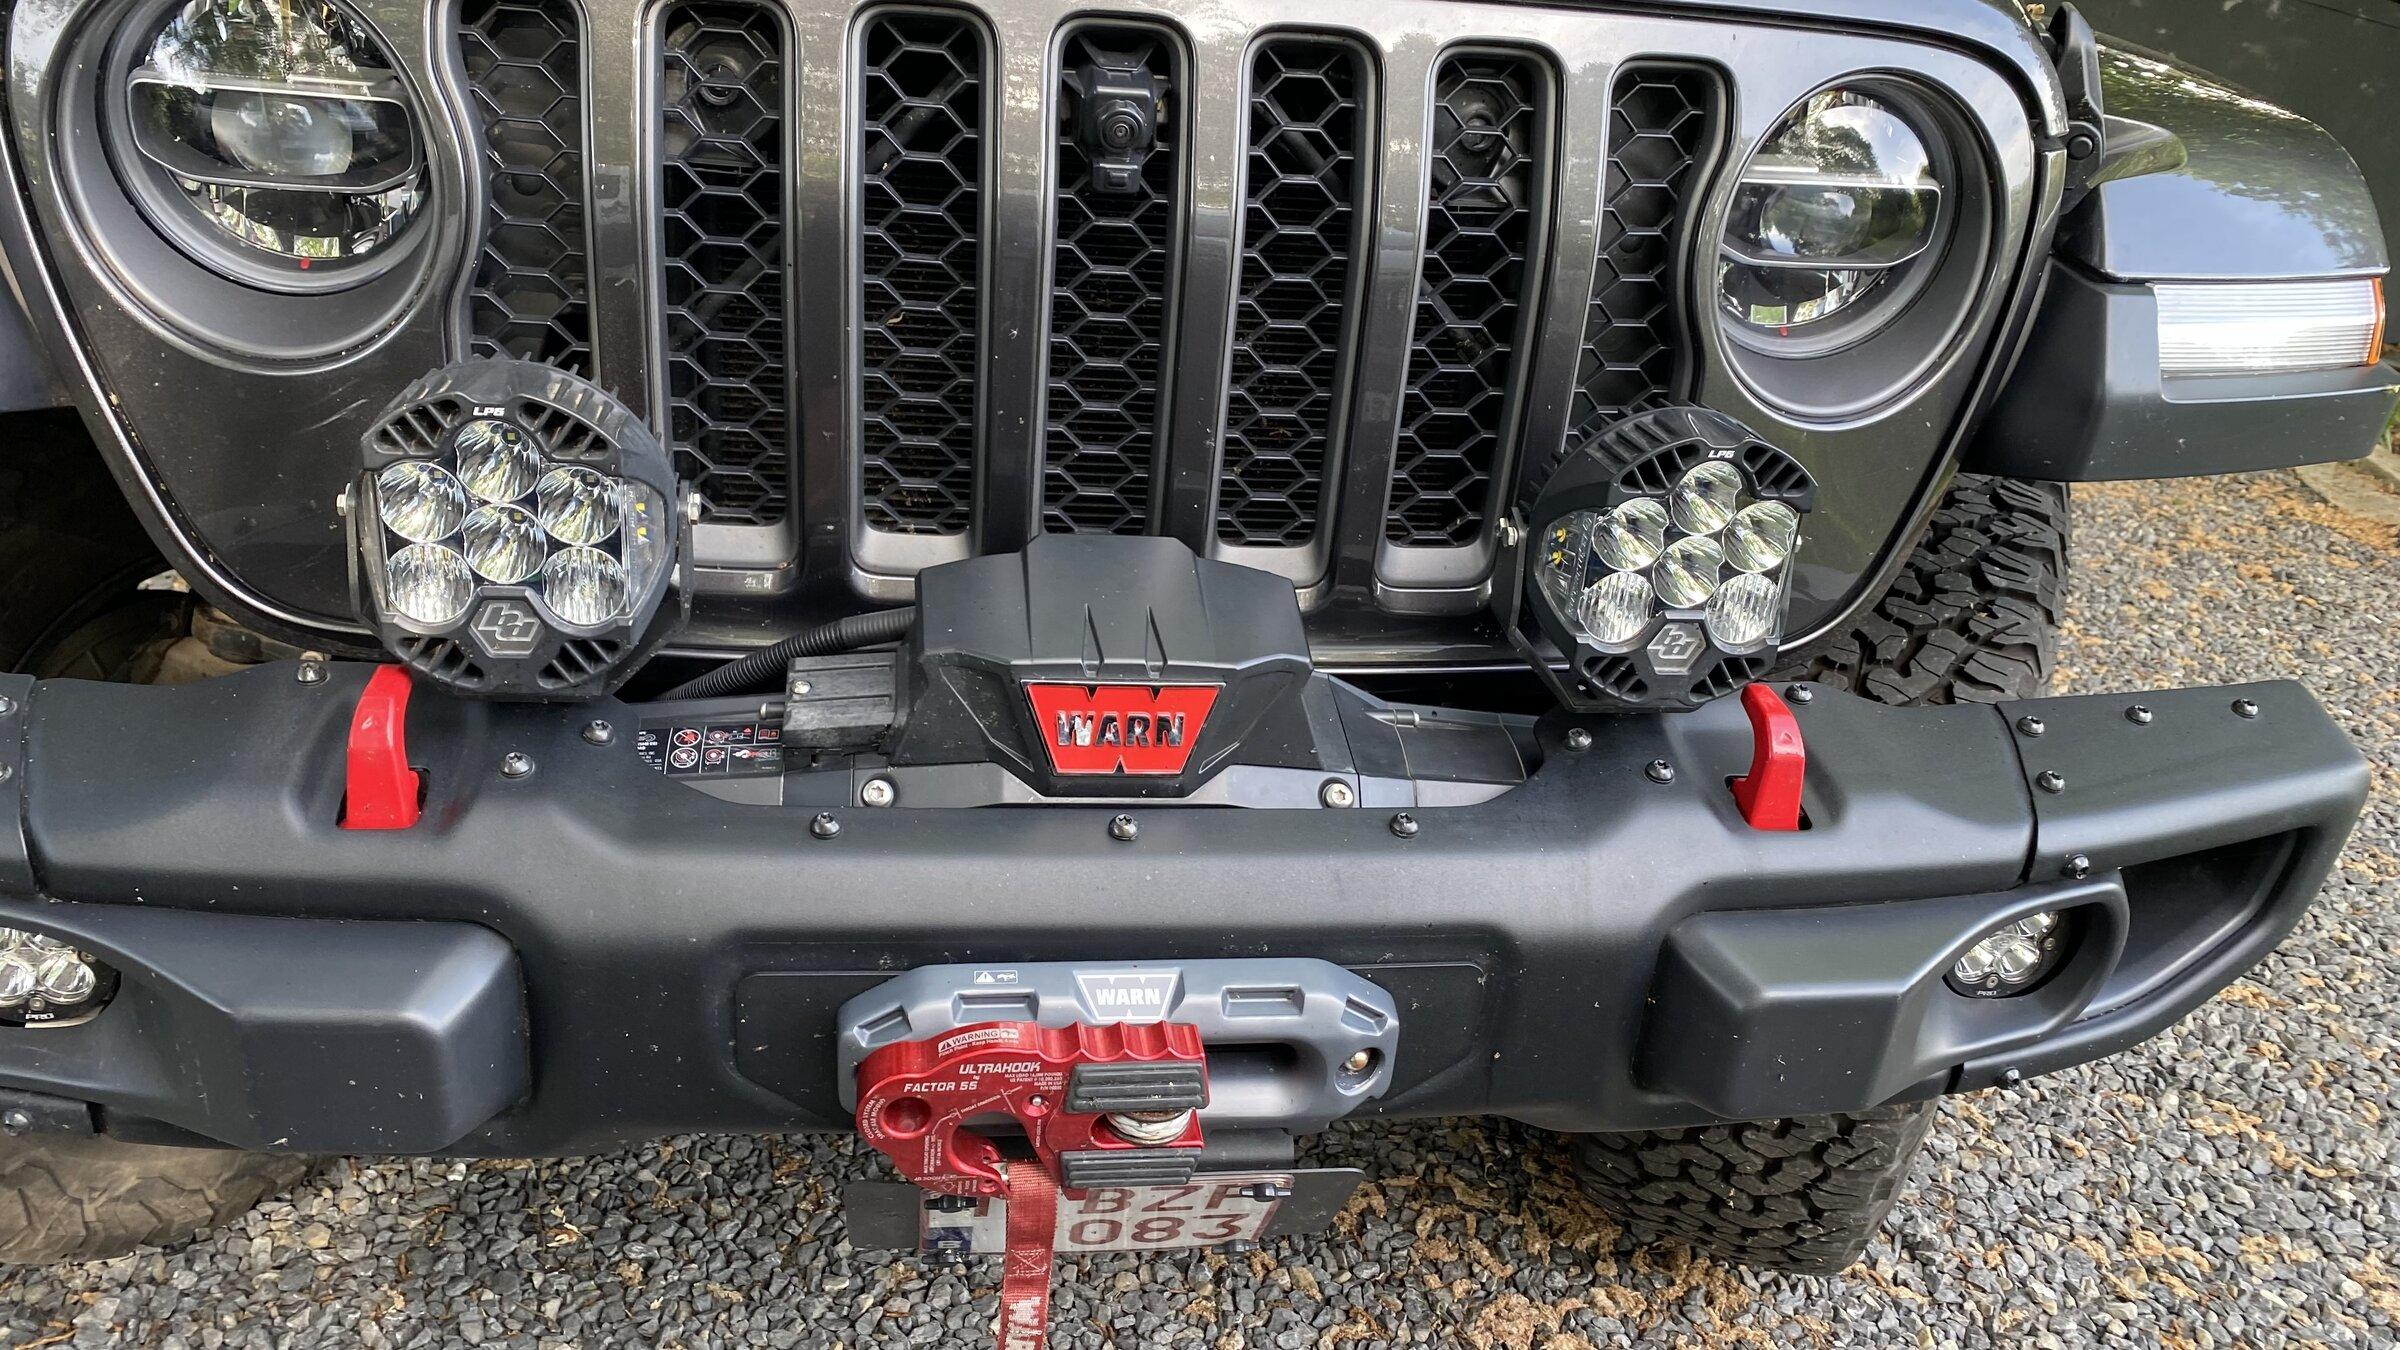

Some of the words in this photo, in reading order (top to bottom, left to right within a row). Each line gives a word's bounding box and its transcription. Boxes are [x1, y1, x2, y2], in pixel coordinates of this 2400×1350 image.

[473, 406, 505, 416] LP6
[1056, 710, 1185, 747] WARN
[1096, 988, 1161, 1006] WARN
[951, 1029, 999, 1046] WARNING
[959, 1061, 1042, 1075] ULTRAHOOK
[903, 1082, 955, 1093] FACTOR
[1068, 1213, 1250, 1246] 083
